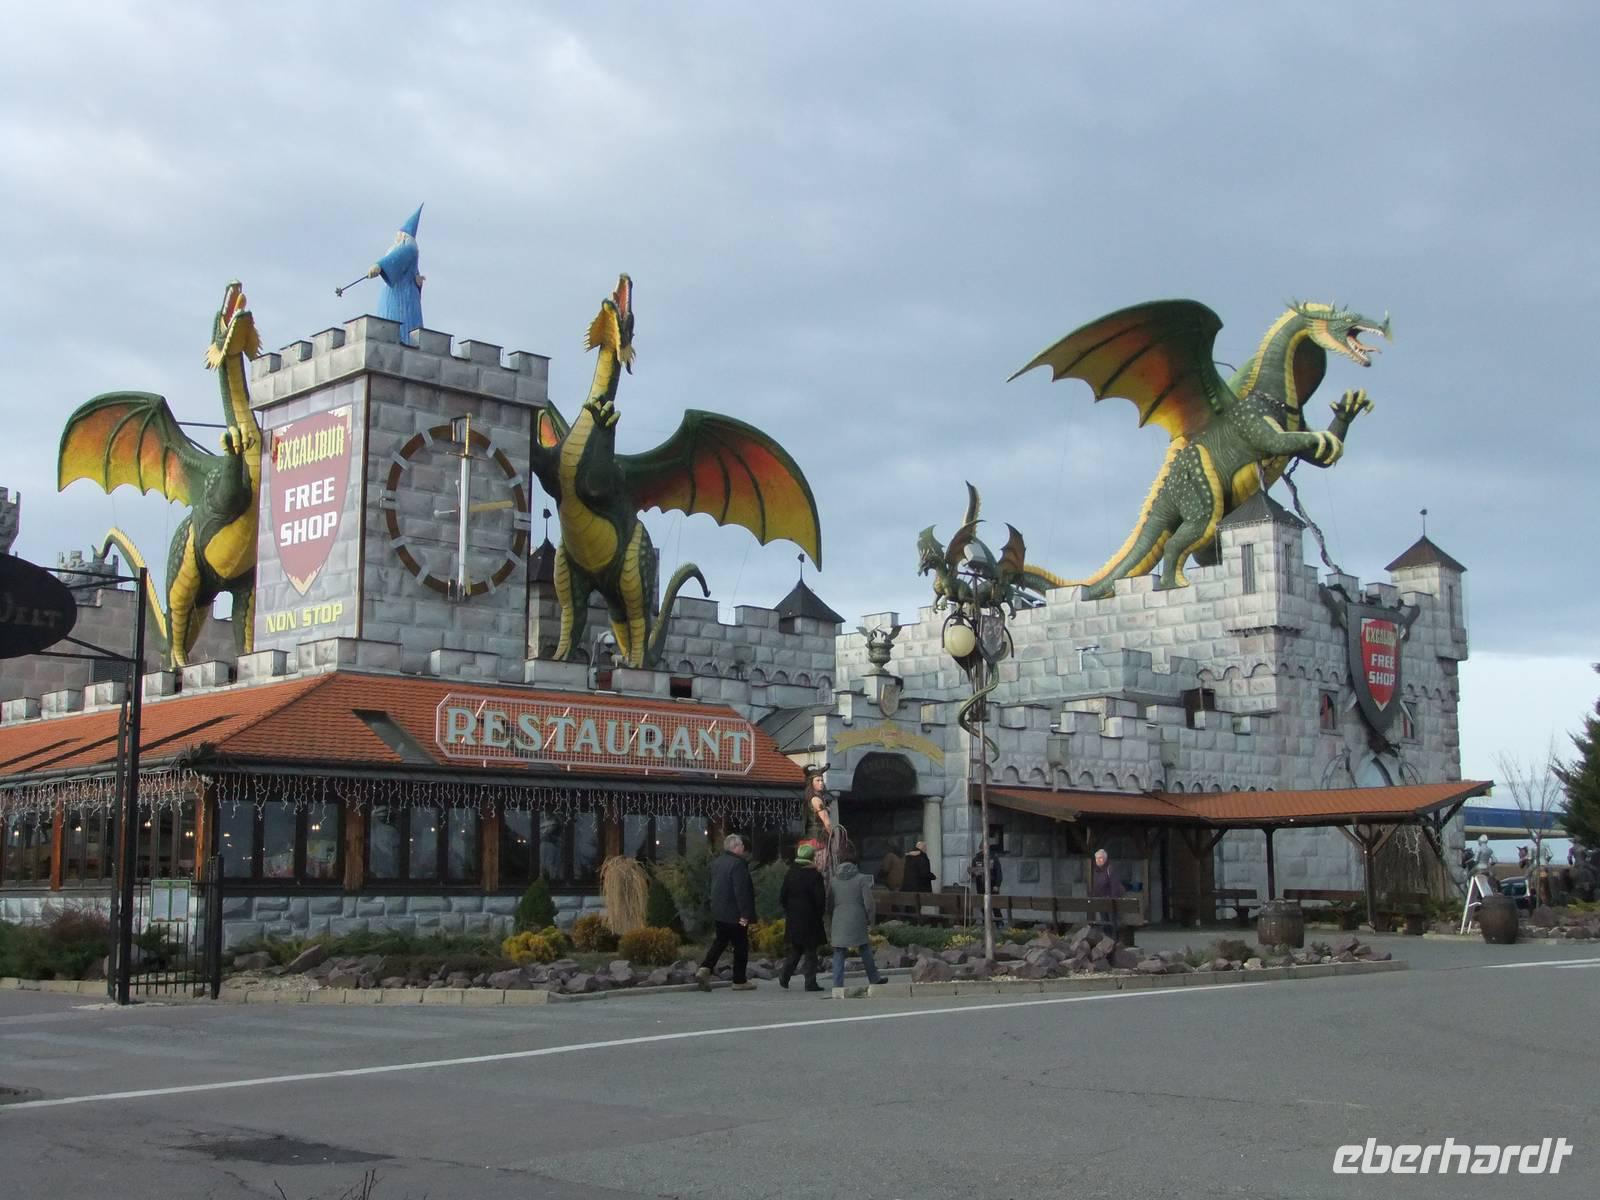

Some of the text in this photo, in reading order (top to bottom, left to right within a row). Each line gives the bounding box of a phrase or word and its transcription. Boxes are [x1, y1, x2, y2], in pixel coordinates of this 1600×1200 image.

[276, 424, 344, 473] EXCALIBUR
[284, 476, 335, 513] FREE
[279, 511, 337, 547] SHOP
[265, 602, 342, 634] NON STOP
[1368, 671, 1395, 686] SHOP
[1371, 653, 1395, 670] FREE
[447, 707, 750, 764] RESTAURANT
